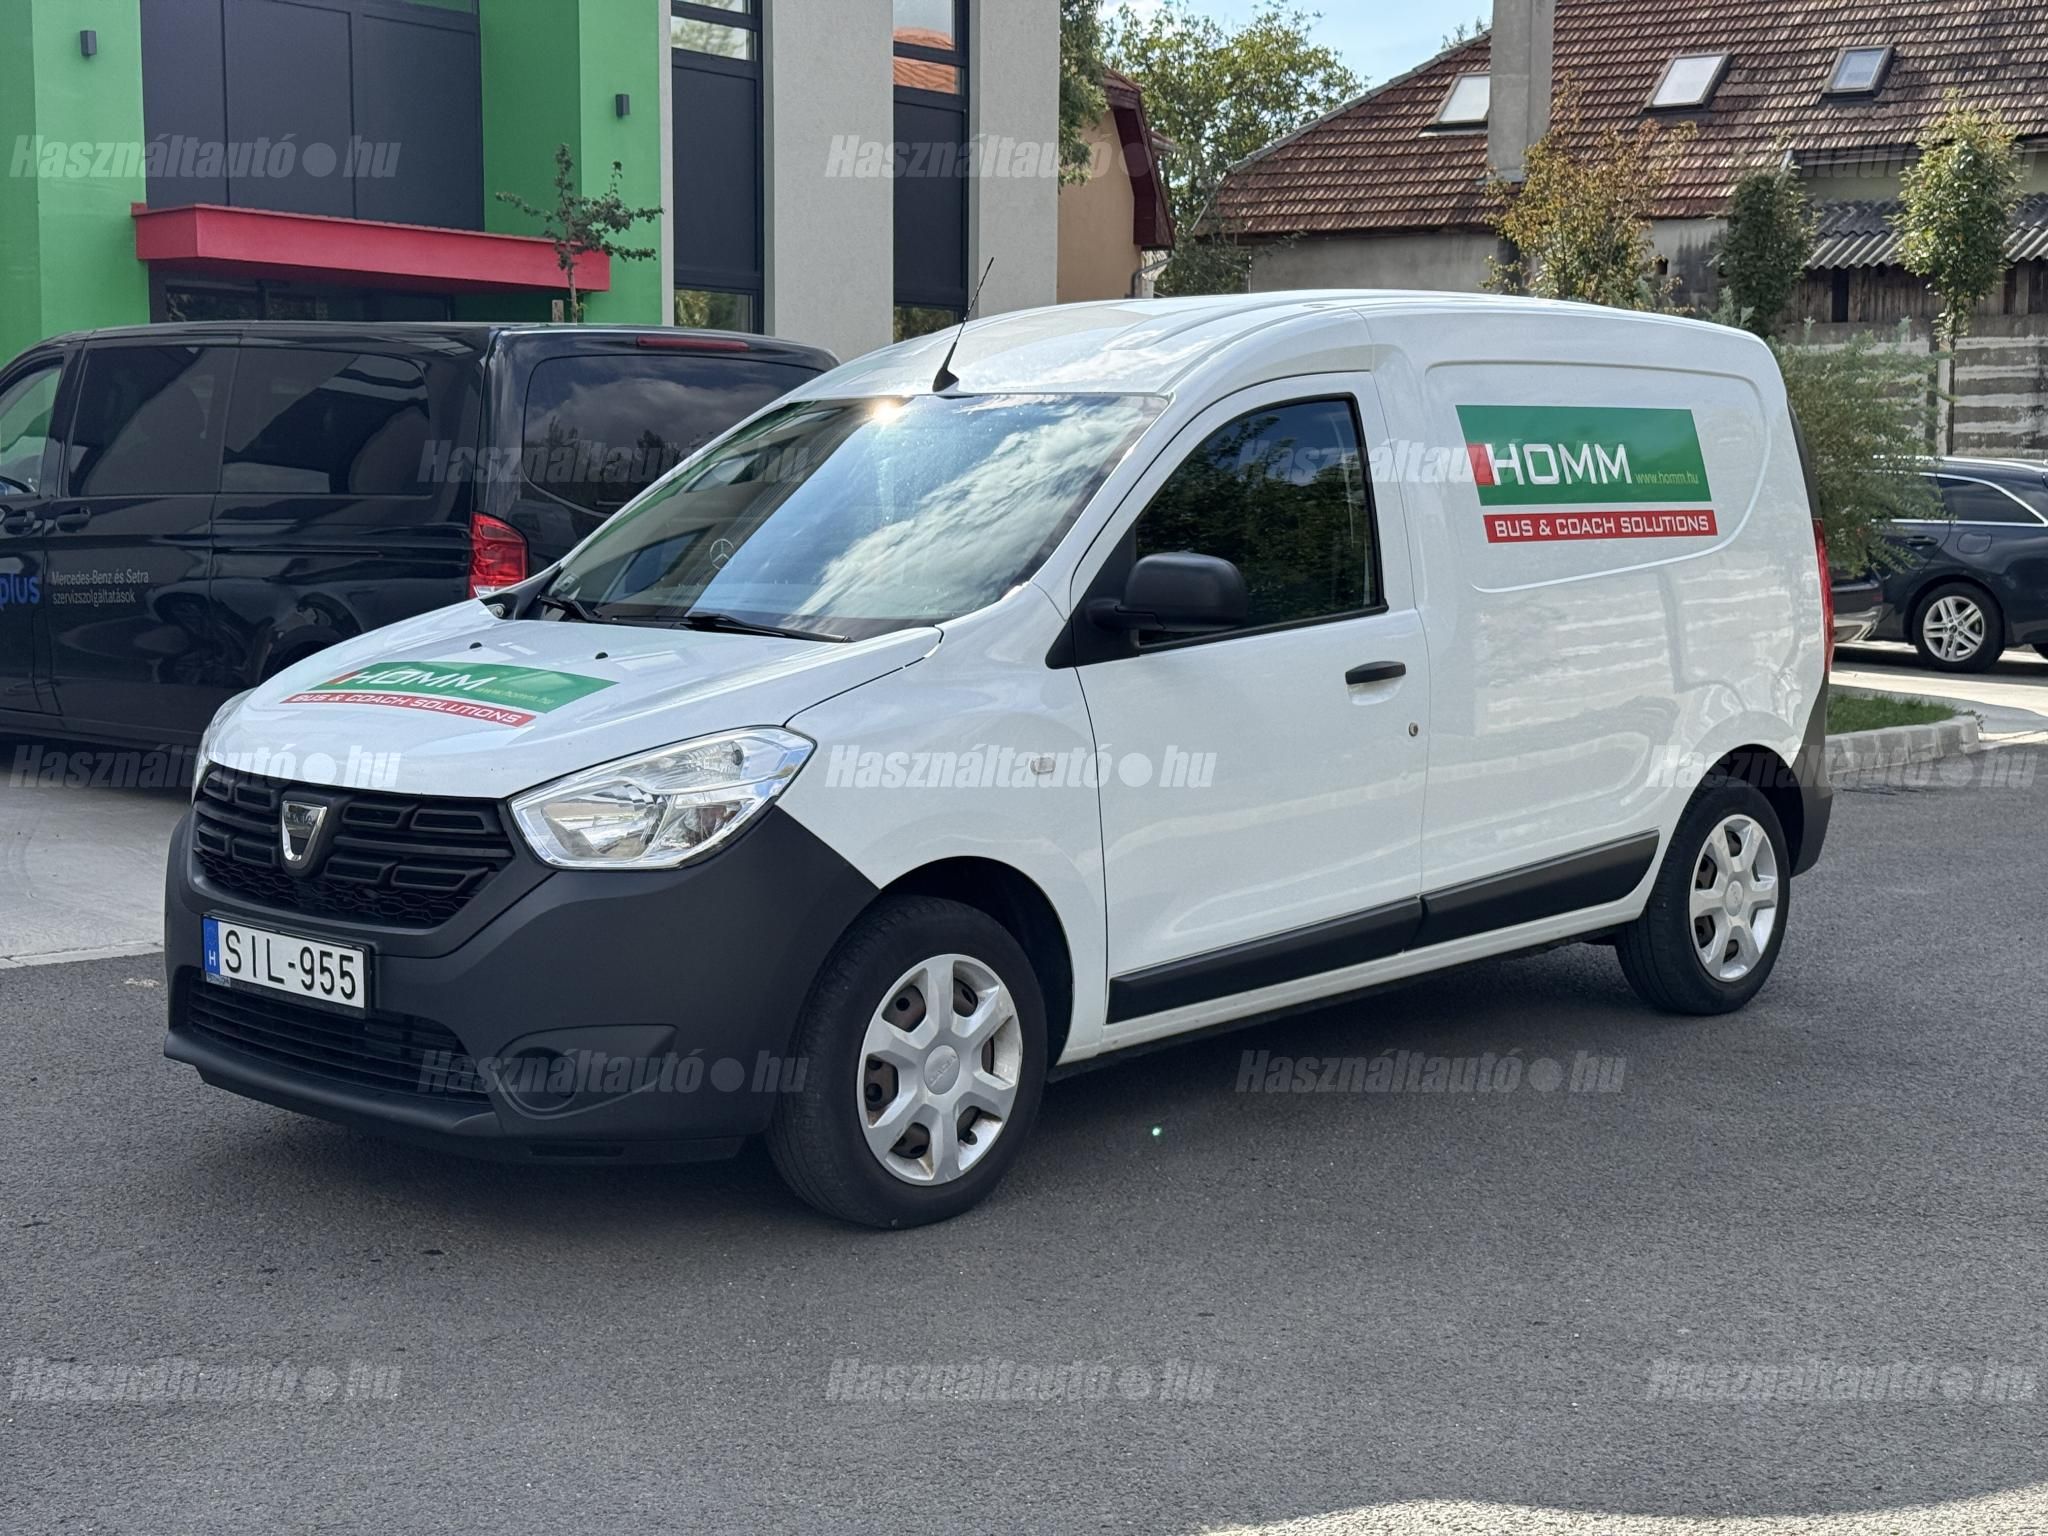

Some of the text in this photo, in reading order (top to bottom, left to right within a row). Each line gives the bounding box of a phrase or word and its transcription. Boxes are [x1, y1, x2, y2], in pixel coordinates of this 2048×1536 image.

[1485, 442, 1633, 485] HOMM
[1635, 471, 1699, 485] www.homm.hu
[1494, 515, 1710, 538] BUS & COACH SOLUTIONS
[51, 568, 149, 586] Mercedes-Benz és Setra
[339, 668, 498, 692] HOMM
[290, 694, 522, 724] BUS & COACH SOLUTIONS
[208, 929, 357, 1000] H SIL-955
